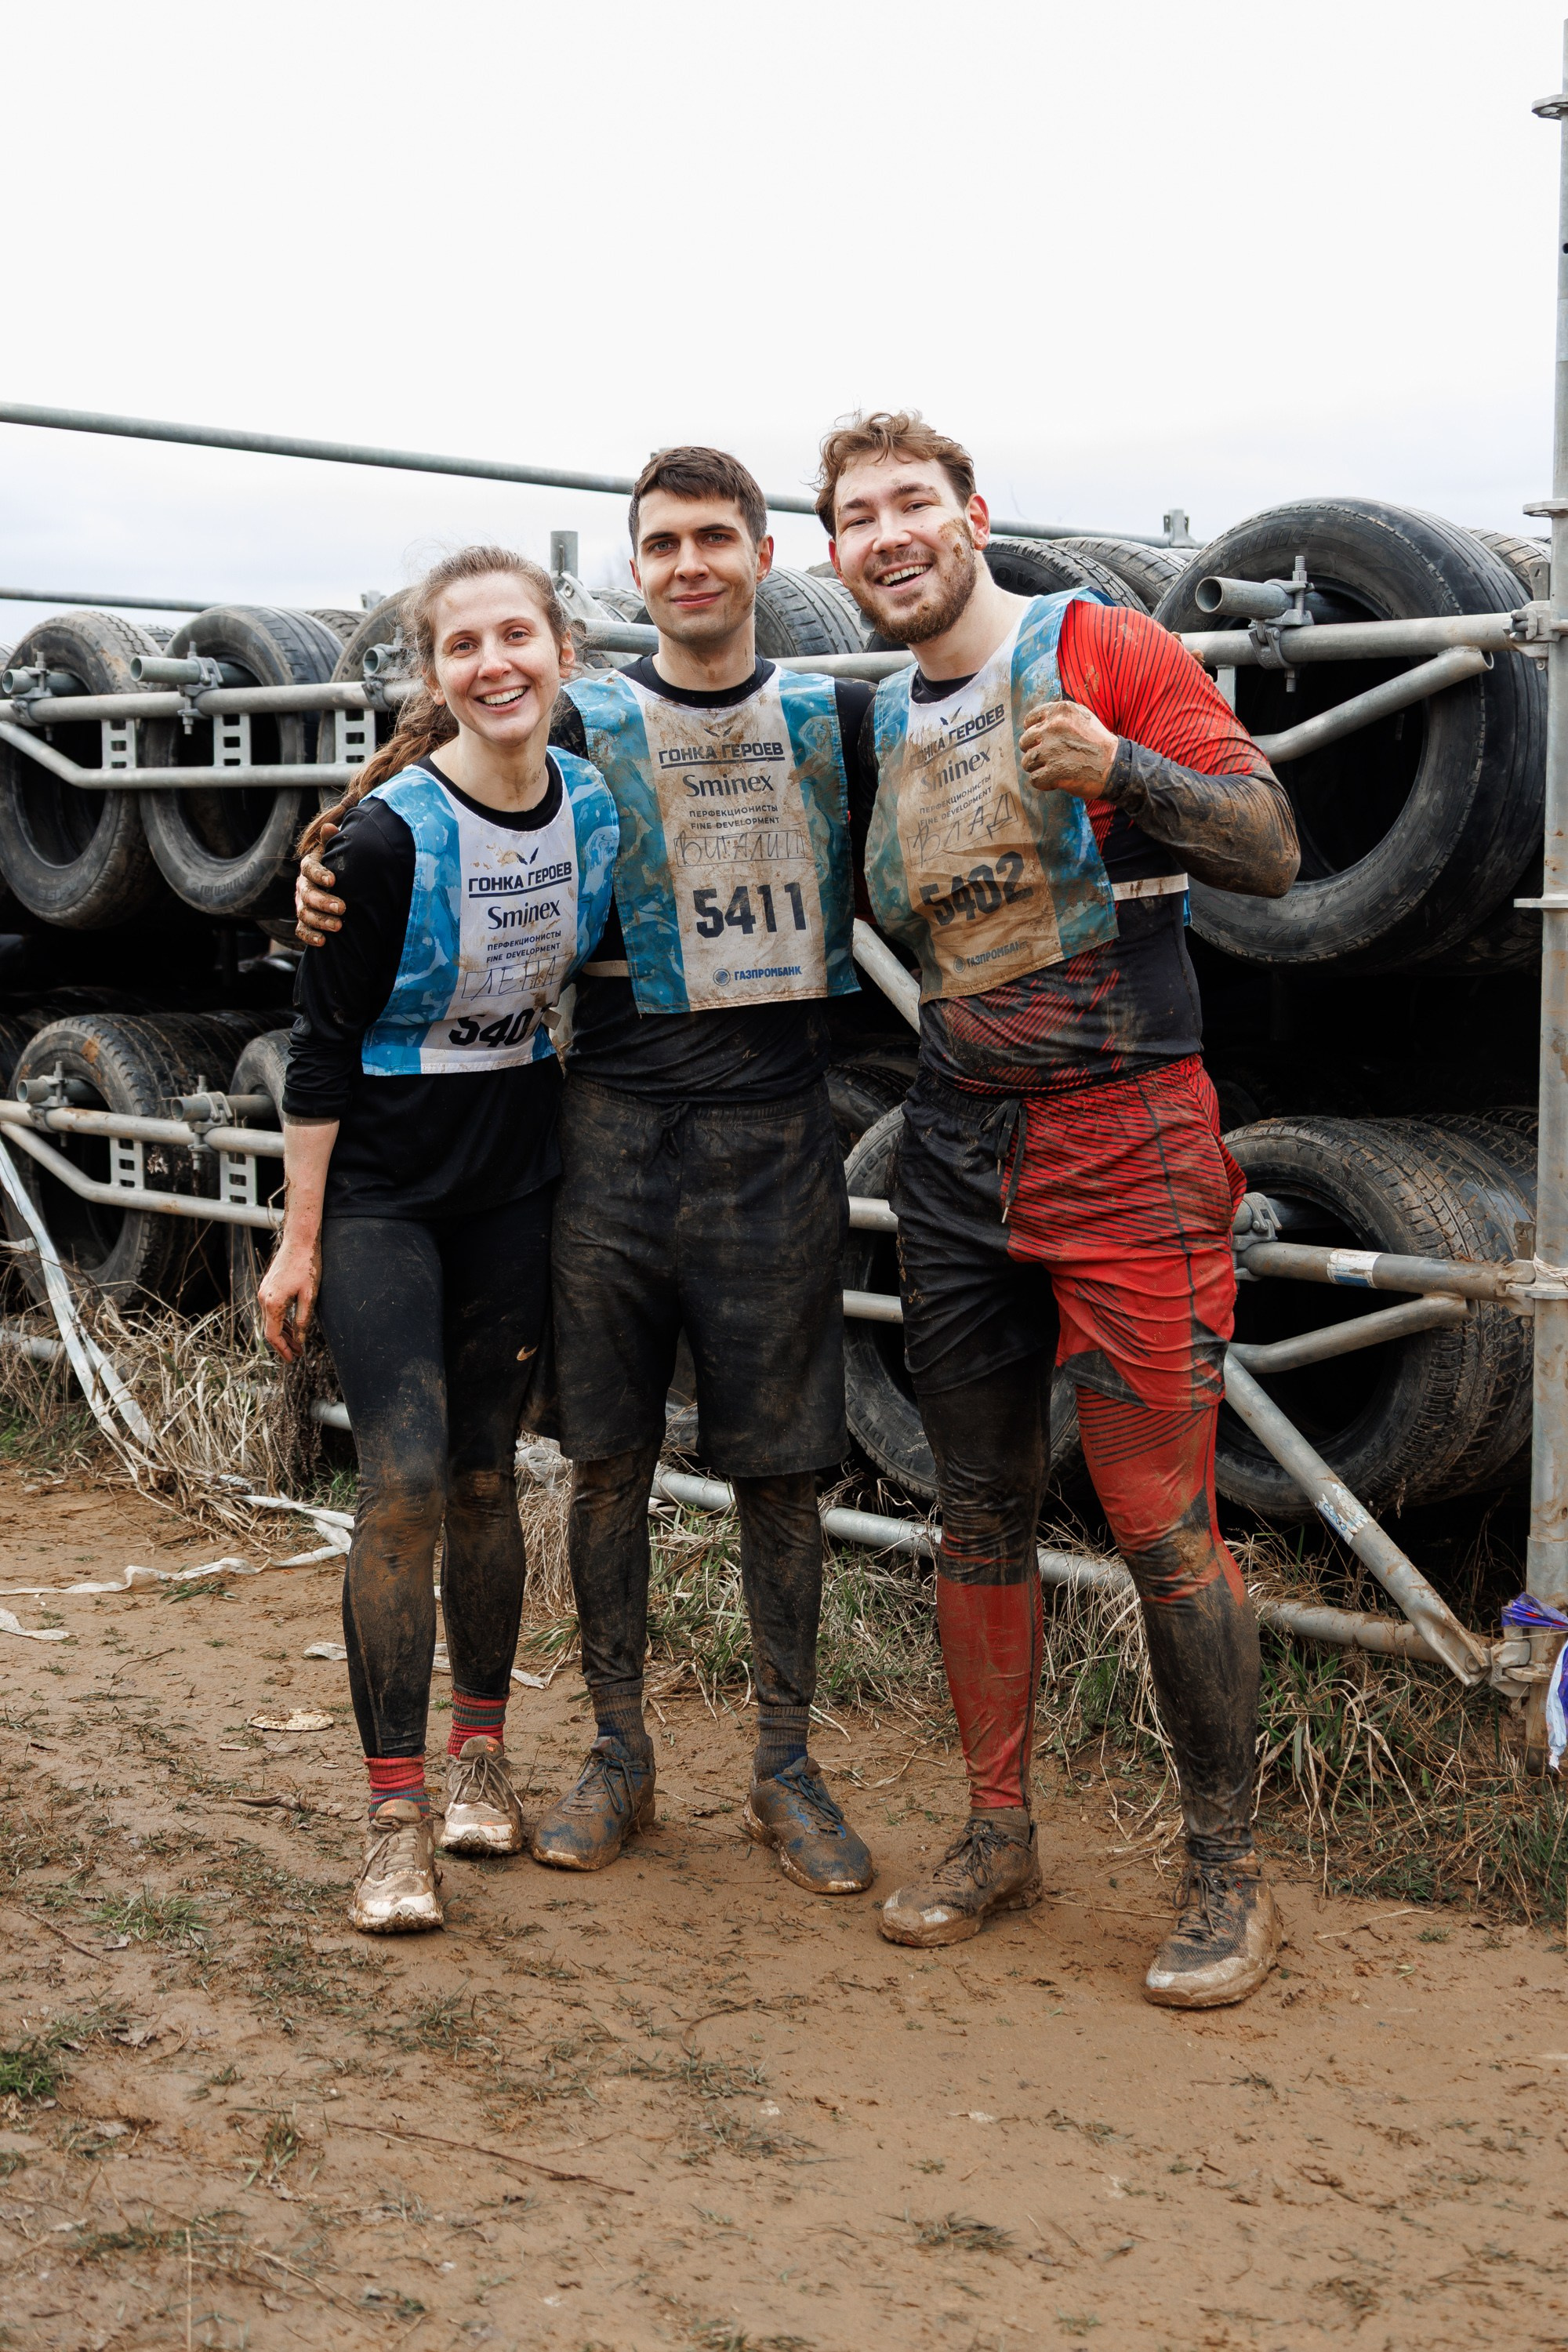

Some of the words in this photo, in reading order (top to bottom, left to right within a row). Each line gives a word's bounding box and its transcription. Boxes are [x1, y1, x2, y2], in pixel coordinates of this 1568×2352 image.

[949, 704, 1004, 745] ГЕРОЕВ
[659, 747, 717, 765] ГОНКА
[722, 742, 783, 760] ГЕРОЕВ
[920, 746, 990, 794] Sminex
[683, 774, 774, 797] Sminex
[920, 775, 991, 815] ПЕРФЕКЦИОНИСТЫ
[689, 804, 778, 818] ПЕРФЕКЦИОНИСТЫ
[716, 817, 780, 829] DEVELOPMENT
[920, 816, 938, 826] FINE
[941, 786, 992, 820] DEVELOPMENT
[913, 793, 1012, 868] ВЛАД
[468, 874, 524, 892] ГОНКА
[528, 862, 572, 887] ГЕРОЕВ
[919, 851, 1033, 927] 5402
[488, 899, 561, 931] Sminex
[693, 882, 806, 938] 5411
[486, 954, 503, 964] FINE
[506, 942, 561, 960] DEVELOPMENT
[487, 931, 561, 952] ПЕРФЕКЦИОНИСТЫ
[470, 955, 559, 1001] ЛЕНА
[735, 965, 802, 981] ГАЗПРОМБАНК
[448, 1002, 553, 1047] 540
